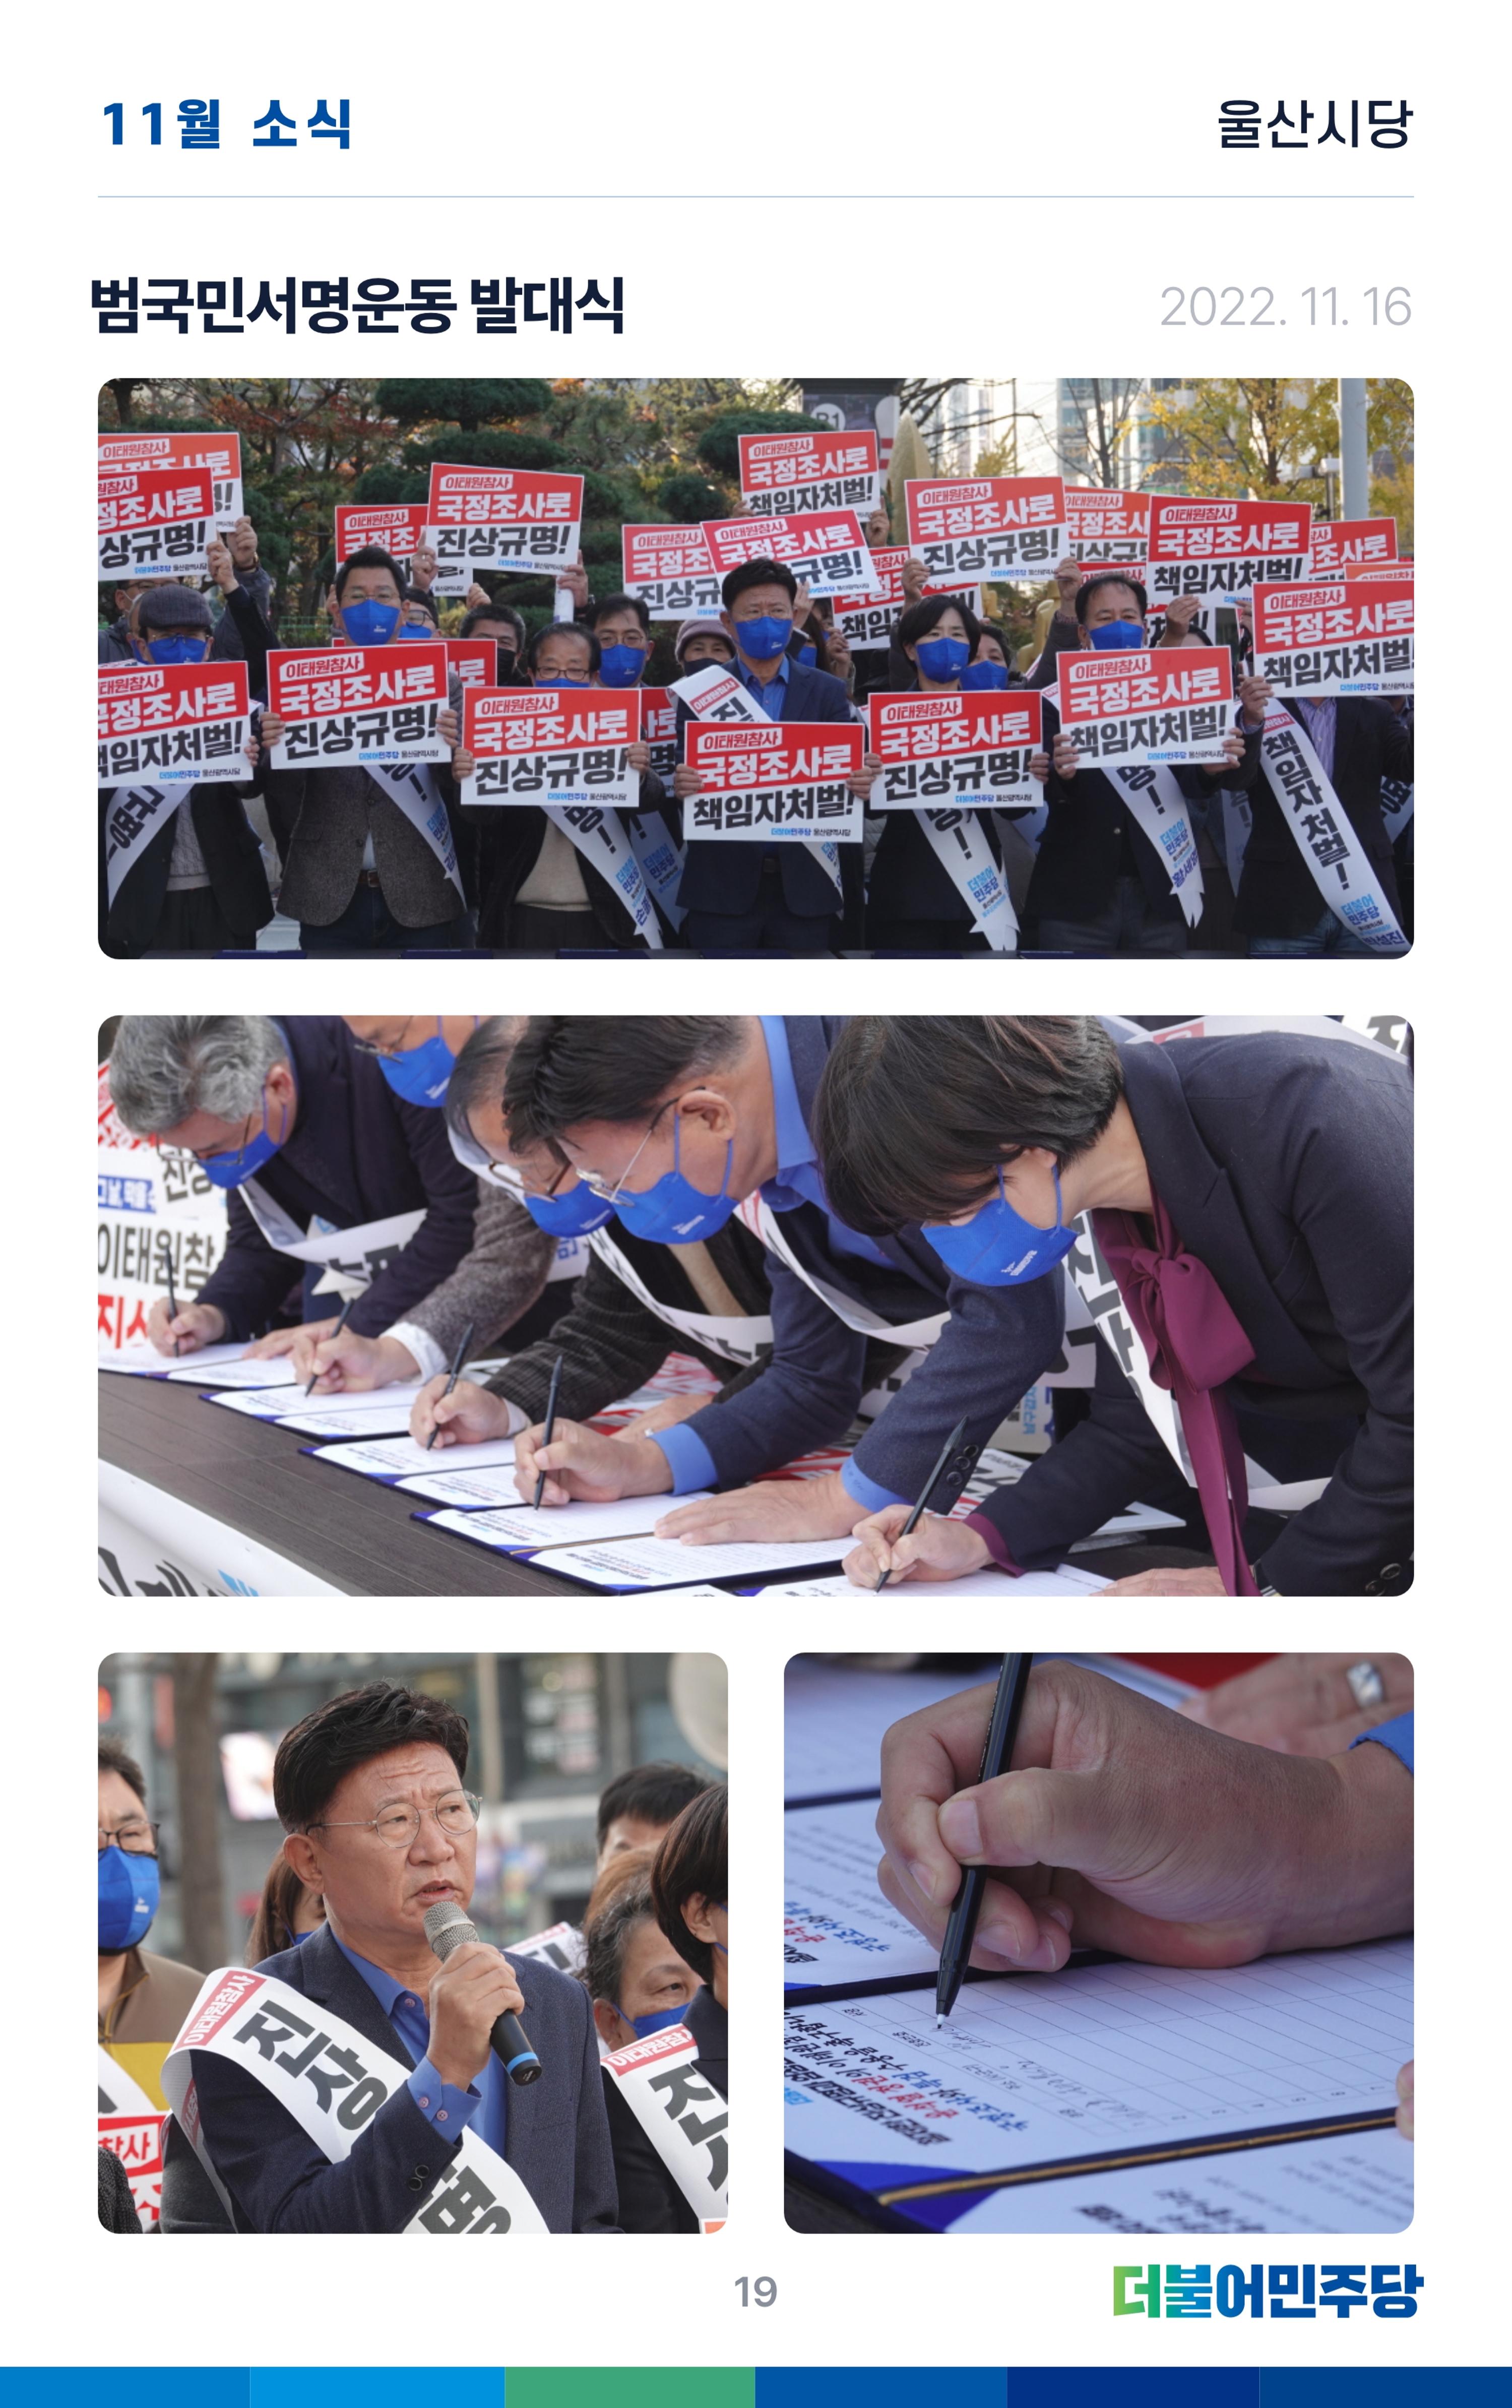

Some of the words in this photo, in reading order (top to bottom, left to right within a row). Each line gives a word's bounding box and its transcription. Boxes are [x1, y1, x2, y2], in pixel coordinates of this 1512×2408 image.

[103, 441, 166, 458] 이태원참사
[754, 440, 810, 456] 이태원참사
[446, 476, 509, 489] 이태원참사
[749, 447, 868, 485] 국정조사로
[437, 492, 571, 521] 국정조사로
[749, 476, 873, 516] 책임자처벌!
[923, 484, 988, 504] 이태원참사
[350, 512, 406, 528] 이태원참사
[721, 520, 784, 540] 이태원참사
[918, 494, 1056, 537] 국정조사로
[1166, 508, 1233, 522] 이태원참사
[101, 521, 206, 570] 상규명!
[437, 525, 571, 558] 진상규명!
[639, 532, 698, 546] 이태원참사
[924, 527, 1058, 577] 진상규명!
[1158, 522, 1299, 556] 국정조사로
[1155, 558, 1303, 595] 책임자처벌!
[1271, 590, 1342, 610] 이태원참사
[1265, 599, 1414, 646] 국정조사로
[286, 656, 360, 678] 이태원참사
[1076, 658, 1147, 679] 이태원참사
[280, 665, 436, 715] 국정조사로
[482, 696, 554, 715] 이태원참사
[1070, 667, 1221, 716] 국정조사로
[888, 701, 958, 721] 이태원참사
[285, 703, 438, 760] 진상규명!
[474, 710, 627, 752] 국정조사로
[704, 731, 778, 750] 이태원참사
[880, 711, 1030, 757] 국정조사로
[1072, 704, 1227, 758] 책임자처벌!
[159, 770, 200, 779] 더불어민주당
[475, 748, 628, 796] 진상규명!
[698, 745, 851, 787] 국정조사로
[884, 749, 1032, 801] 진상규명!
[694, 783, 854, 830] 책임자처벌!
[1263, 730, 1351, 890] 책임자처벌!
[183, 1974, 257, 2045] 이태원참사
[844, 2047, 909, 2071] 수용을
